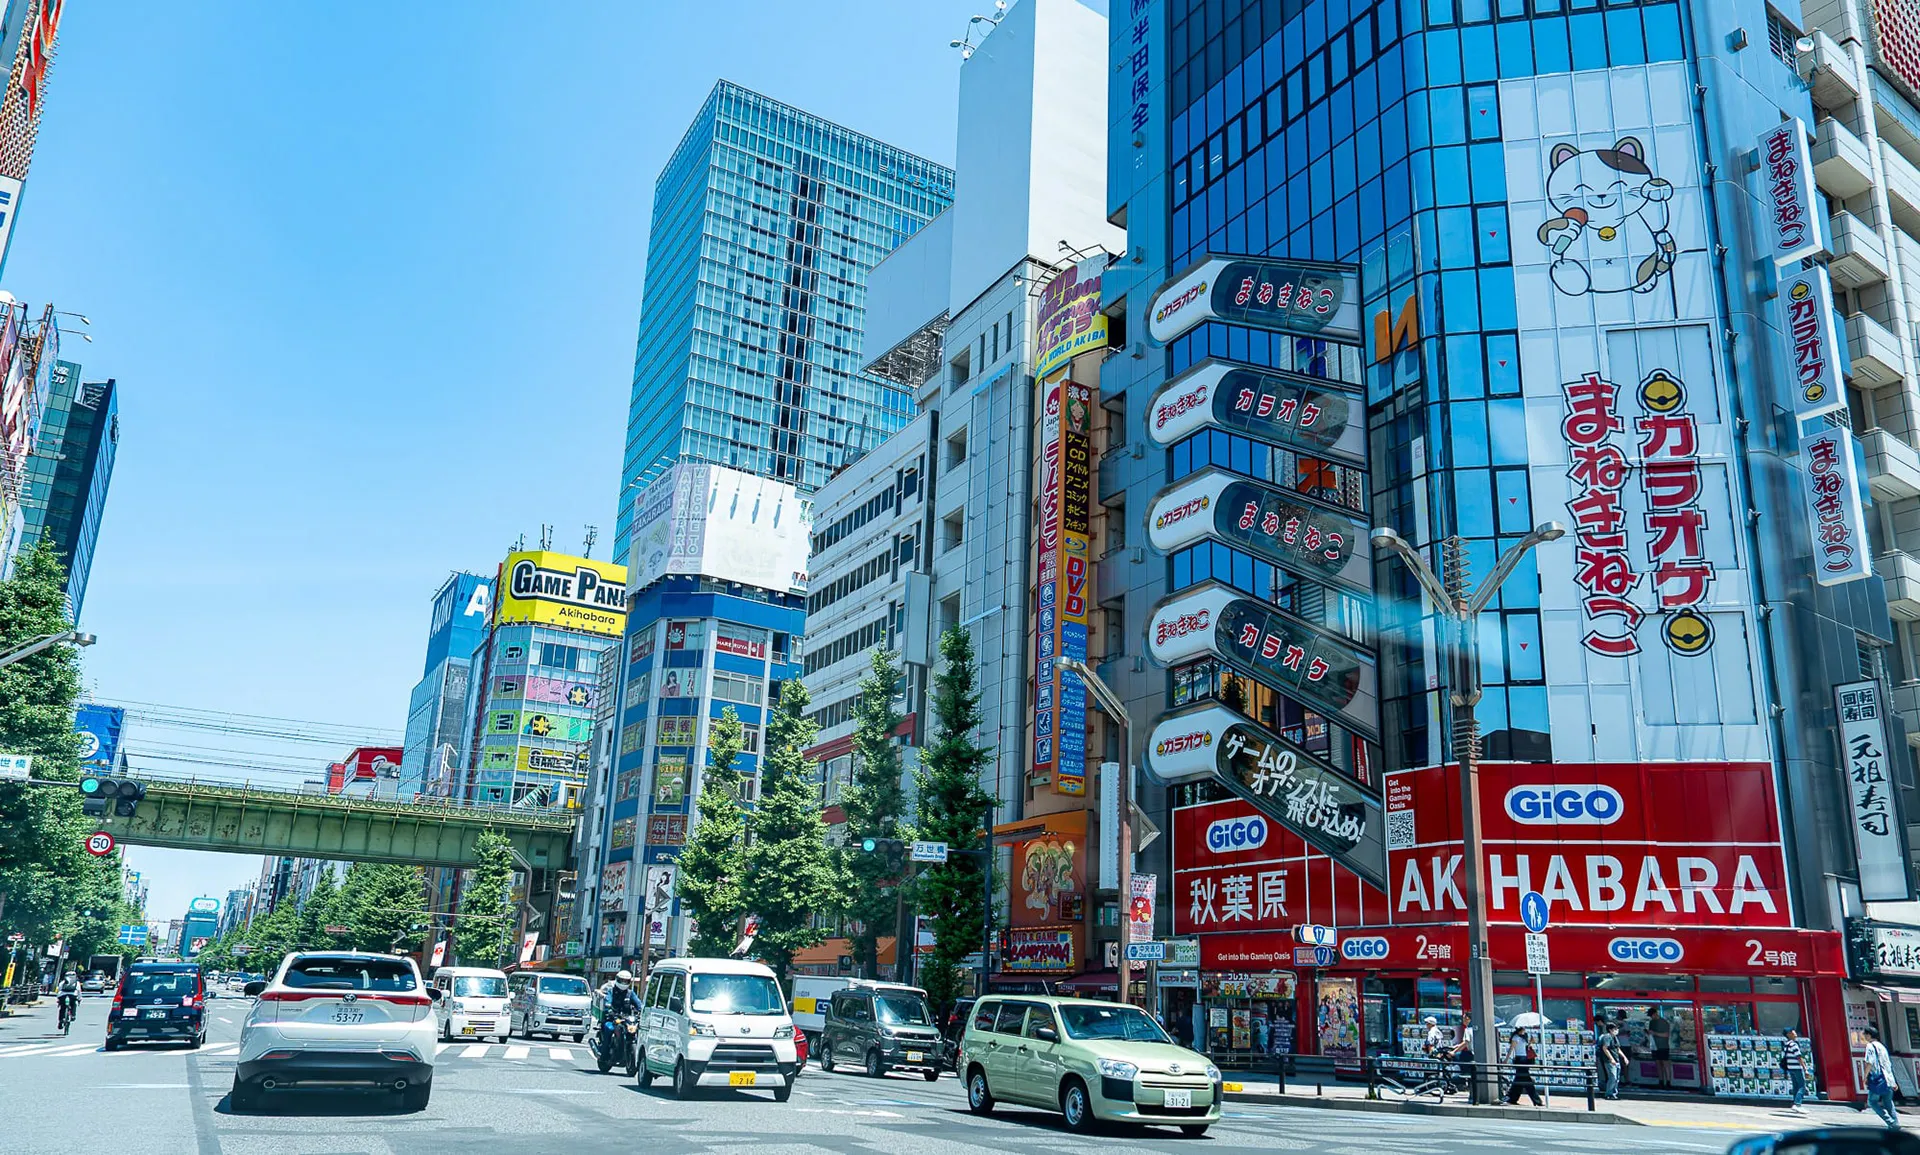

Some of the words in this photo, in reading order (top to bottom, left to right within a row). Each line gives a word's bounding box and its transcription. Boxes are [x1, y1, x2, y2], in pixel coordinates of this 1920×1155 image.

[1766, 129, 1806, 249] まねきねこ
[1161, 285, 1201, 320] カラオケ
[1235, 276, 1334, 314] まねきねこ
[1049, 341, 1072, 364] WORLD
[1074, 328, 1106, 347] AKIBA
[1789, 298, 1824, 385] カラオケ
[1156, 385, 1209, 431] まねきねこ
[1235, 388, 1321, 428] カラオケ
[1067, 432, 1089, 449] ゲーム
[1069, 448, 1086, 461] CD
[1066, 460, 1089, 476] アイドル
[1066, 474, 1089, 490] アニメ
[691, 467, 707, 531] WELCOME
[1066, 489, 1088, 504] コミック
[1066, 503, 1087, 516] ホビー
[1638, 414, 1716, 607] カラオケ
[1809, 437, 1853, 572] まねきねこ
[673, 472, 691, 554] AKIHABARA
[1065, 517, 1087, 532] フィギュア
[1162, 498, 1202, 528] カラオケ
[1564, 373, 1643, 656] まねきねこ
[1239, 501, 1343, 560] まねきねこ
[513, 562, 571, 599] GAME
[1065, 555, 1087, 617] DVD
[558, 606, 616, 625] Akihabara
[1156, 609, 1210, 647] まねきねこ
[1239, 622, 1329, 682] カラオケ
[1164, 731, 1205, 755] カラオケ
[1225, 734, 1297, 776] ゲームの
[1250, 767, 1339, 808] オアシスに
[1388, 779, 1399, 787] Get
[1848, 734, 1891, 836] 元祖寿司
[1389, 794, 1411, 802] Gaming
[1389, 802, 1405, 810] Oasis
[1510, 790, 1618, 819] GiGO
[92, 838, 109, 849] 50
[1209, 819, 1265, 848] GiGO
[1190, 869, 1289, 926] 秋葉原
[1398, 854, 1778, 915] AKHABARA
[1175, 944, 1198, 953] Pepper
[1175, 953, 1197, 962] Lunch
[1250, 952, 1272, 961] Gaming
[1274, 952, 1290, 960] Oasis
[1317, 948, 1326, 961] 17
[1344, 940, 1387, 957] GiGO
[1416, 935, 1451, 960] 2号館
[1611, 940, 1681, 960] GiGO
[1745, 939, 1797, 967] 2号館
[336, 1014, 363, 1022] 53-77
[1170, 1097, 1189, 1106] 31-21
